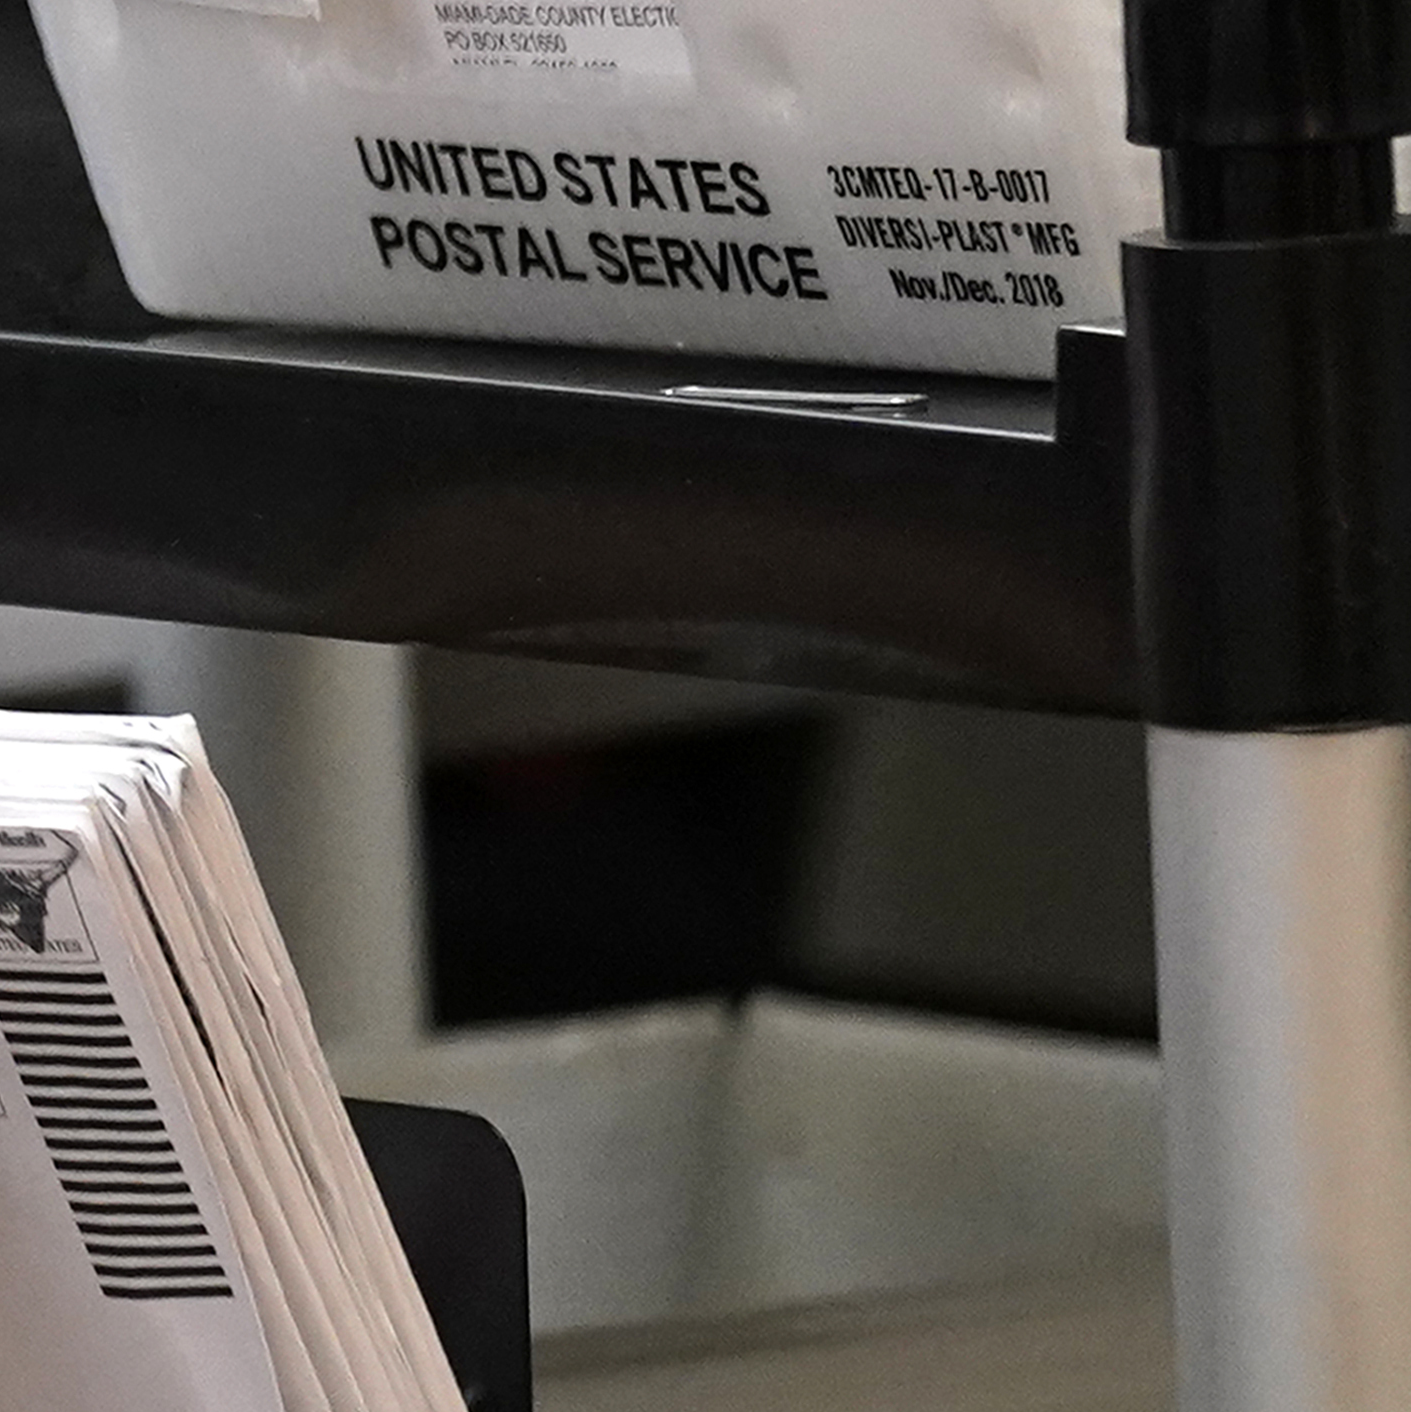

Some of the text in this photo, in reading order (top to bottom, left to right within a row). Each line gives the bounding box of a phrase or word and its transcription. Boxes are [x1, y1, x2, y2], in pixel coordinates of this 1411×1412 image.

[535, 5, 606, 26] COUNTY
[444, 30, 470, 50] PO
[472, 31, 505, 51] BOX
[355, 136, 770, 218] UNITED STATES
[370, 215, 828, 300] POSTAL SERVICE
[1005, 271, 1064, 308] 2018
